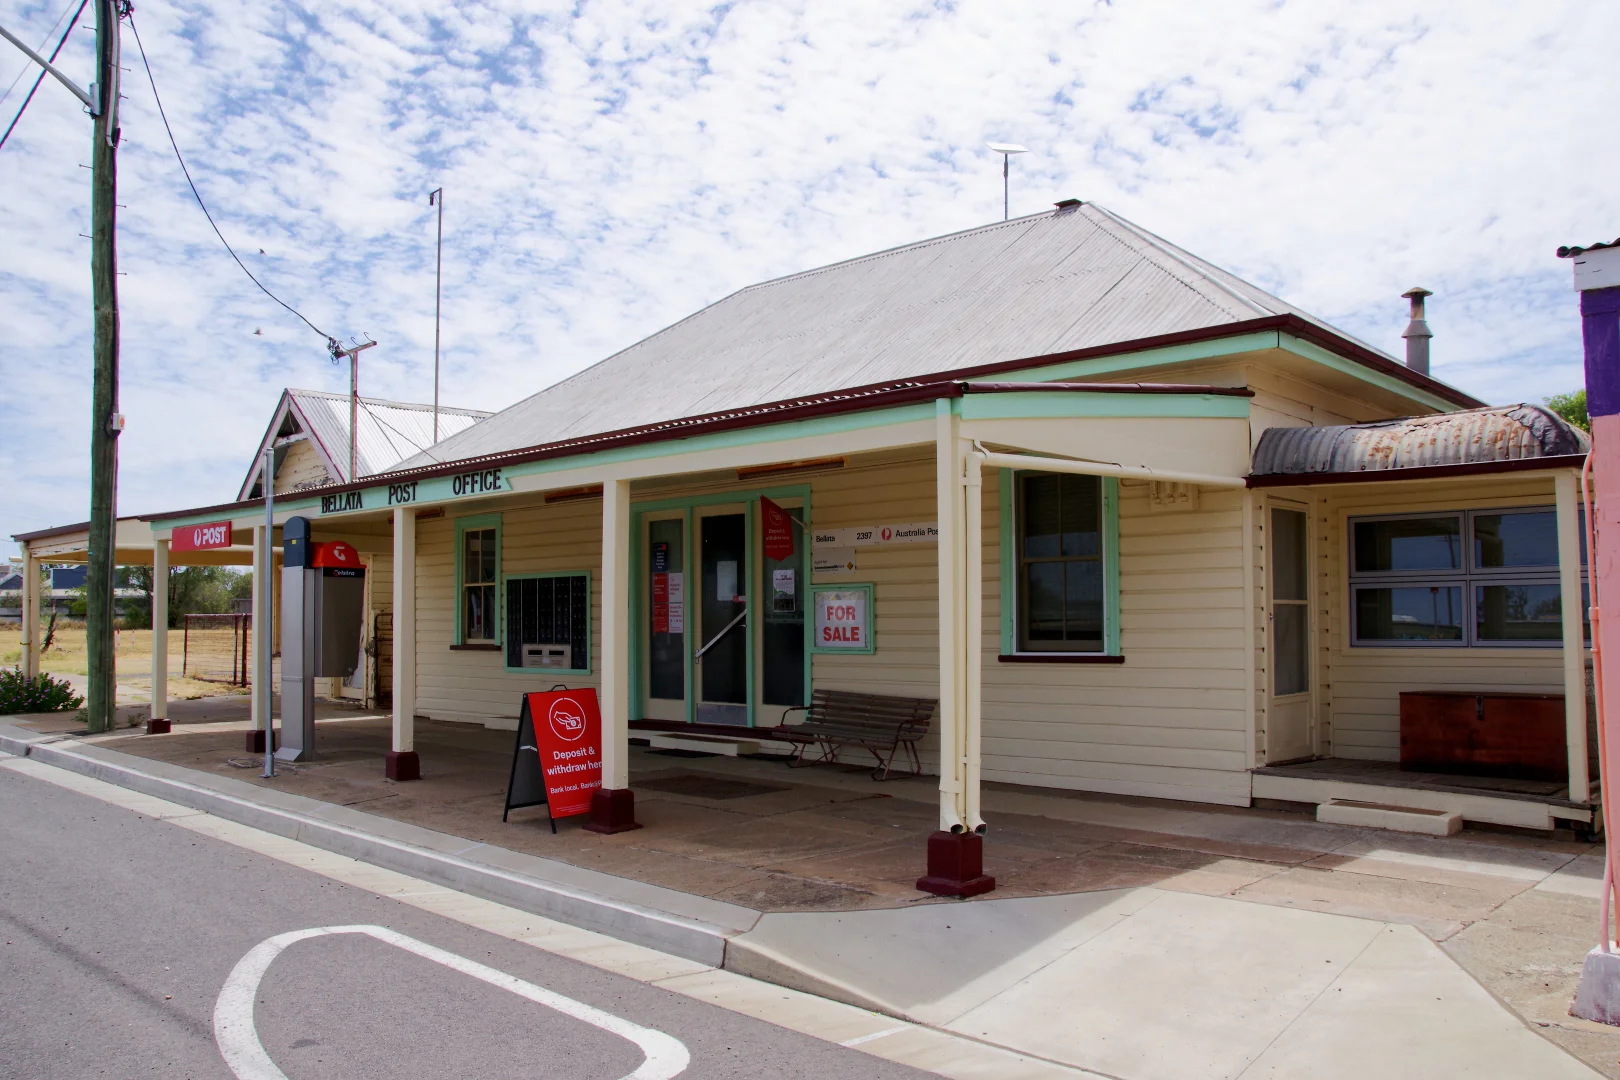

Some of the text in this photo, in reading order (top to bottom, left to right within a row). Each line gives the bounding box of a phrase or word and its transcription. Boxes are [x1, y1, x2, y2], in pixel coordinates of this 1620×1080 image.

[321, 469, 502, 514] BELLATA POST OFFICE
[202, 526, 226, 545] POST
[815, 527, 938, 543] Bellata 2397 Australia Pos
[333, 569, 355, 577] Telstra
[826, 605, 856, 621] FOR
[822, 626, 860, 642] SALE
[553, 746, 595, 760] Deposit &
[547, 760, 602, 776] withdraw her
[550, 779, 602, 794] Bank local. Bank@P
